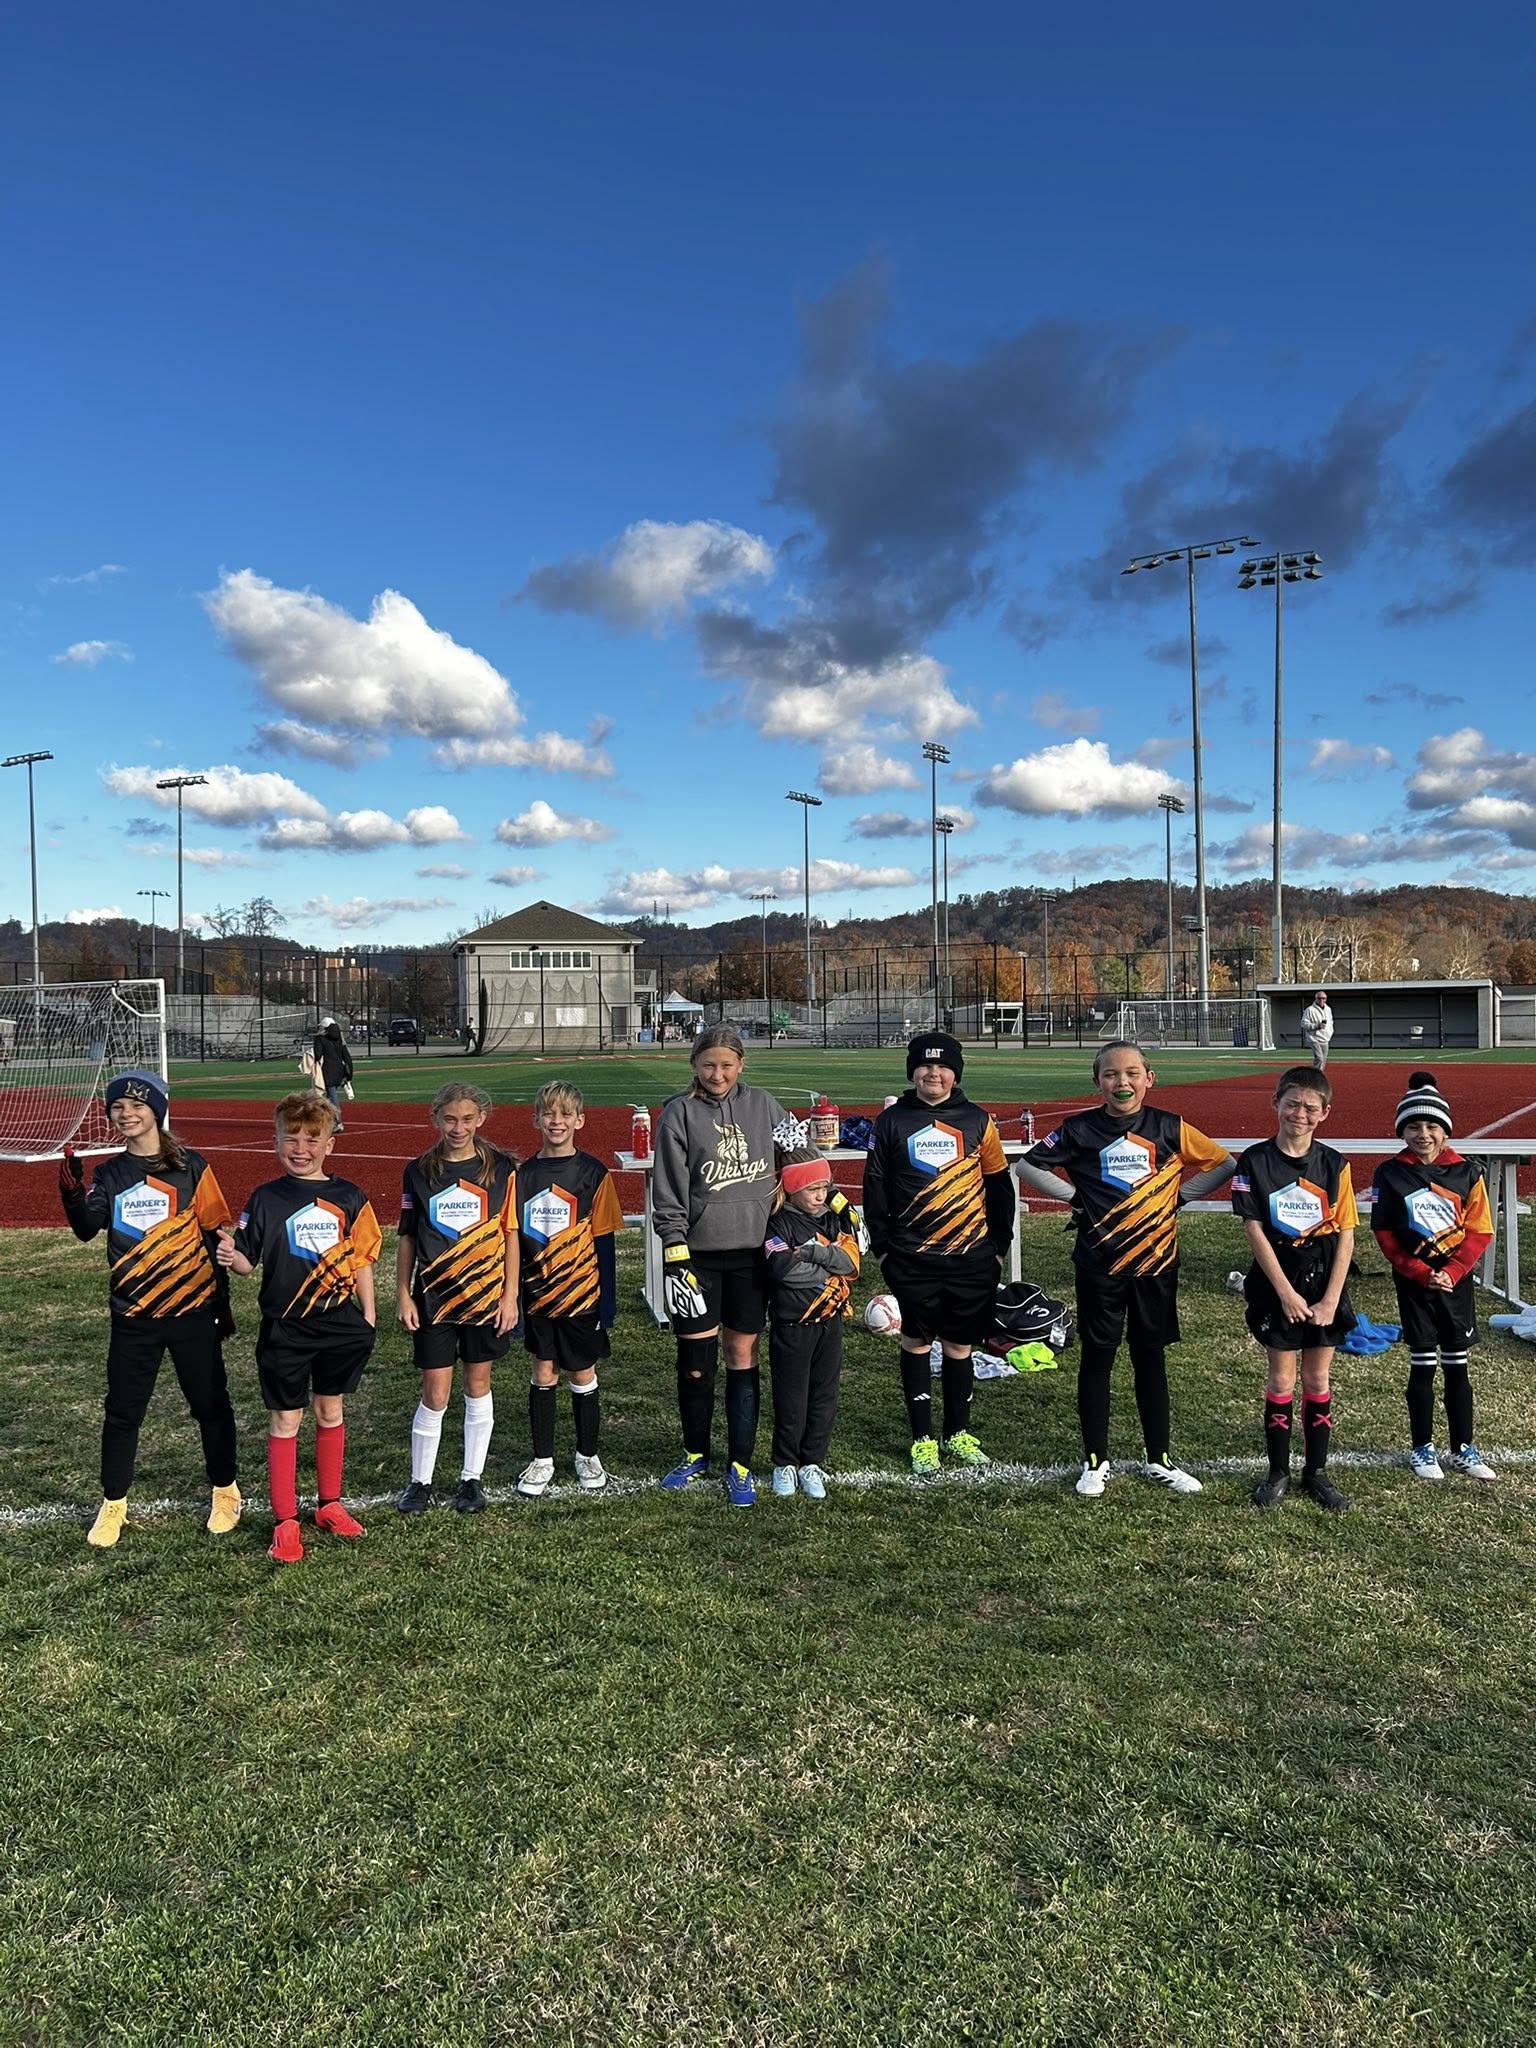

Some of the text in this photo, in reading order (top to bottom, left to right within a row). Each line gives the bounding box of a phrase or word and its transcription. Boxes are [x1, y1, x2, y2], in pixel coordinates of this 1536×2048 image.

[925, 1048, 941, 1058] CAT
[916, 1140, 955, 1148] PARKER'S
[1108, 1154, 1148, 1164] PARKER'S
[700, 1158, 768, 1184] Vikings
[123, 1199, 167, 1209] PARKER'S
[438, 1201, 479, 1210] PARKER'S
[1278, 1201, 1320, 1211] PARKER'S
[531, 1207, 569, 1216] PARKER'S
[295, 1222, 338, 1232] PARKER'S
